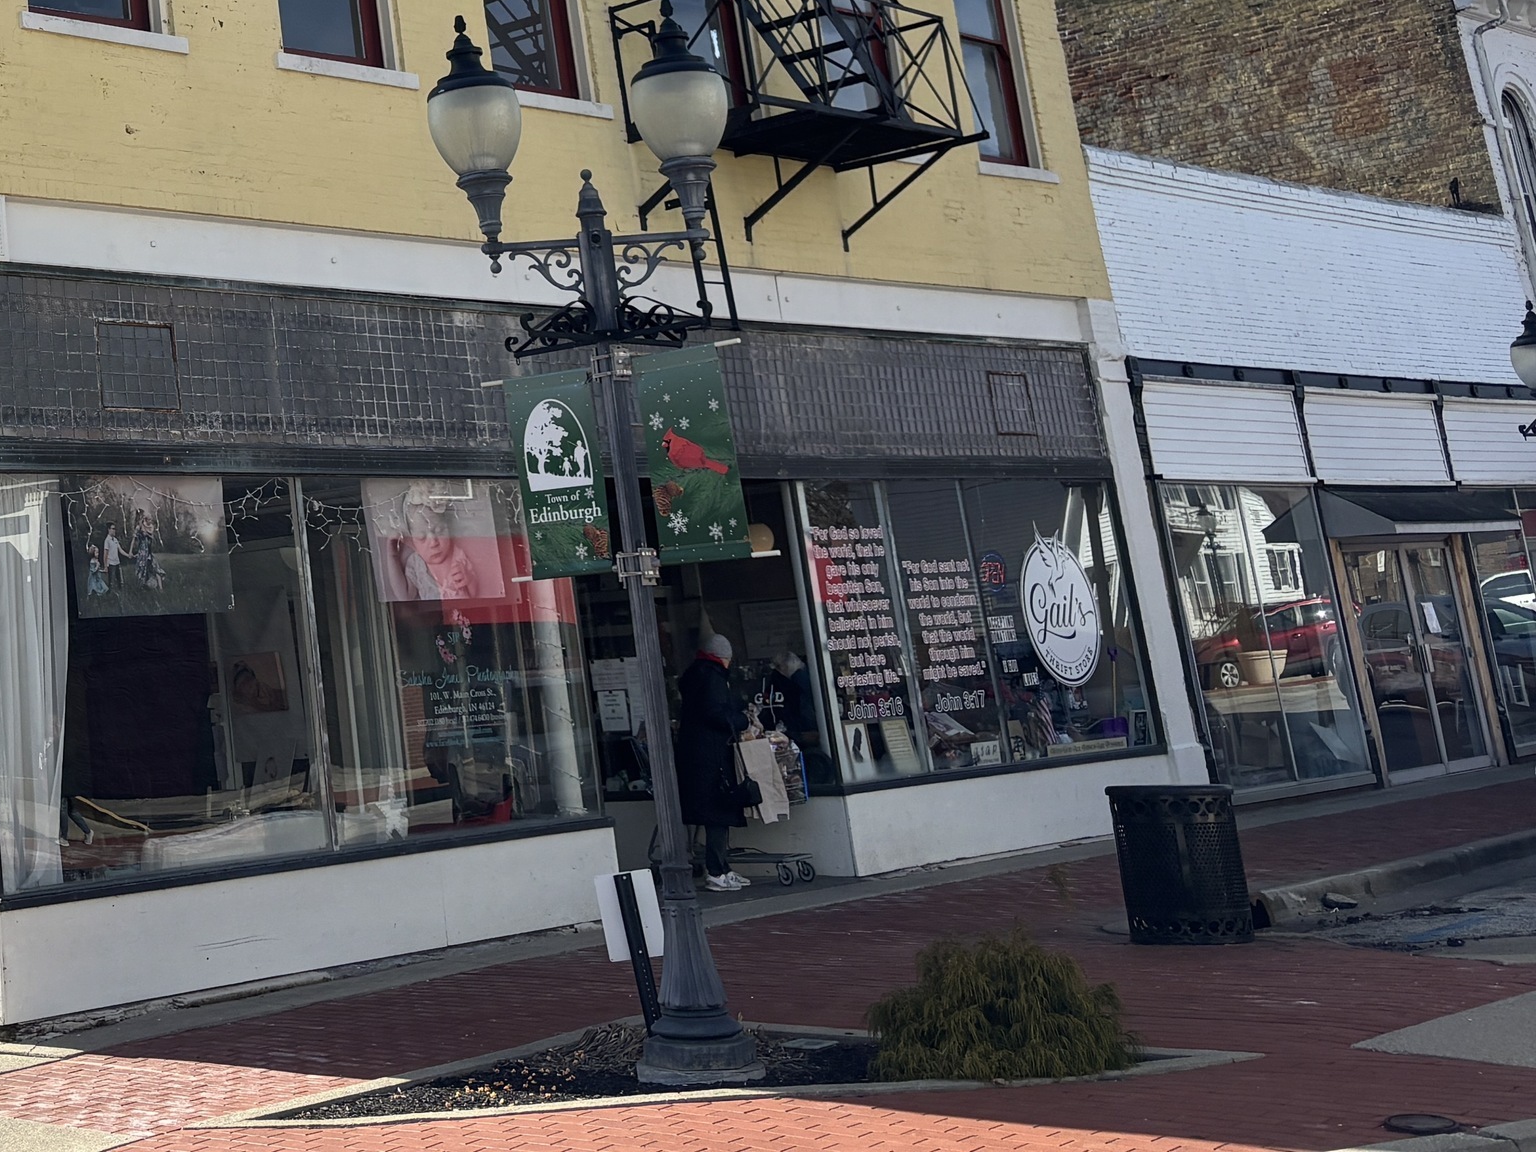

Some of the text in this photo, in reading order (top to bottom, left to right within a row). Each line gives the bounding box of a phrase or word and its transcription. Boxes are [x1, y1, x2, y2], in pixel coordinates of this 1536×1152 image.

[545, 490, 580, 504] Town of
[529, 502, 602, 524] Edinburgh
[829, 526, 848, 540] God
[848, 528, 860, 540] so
[860, 525, 883, 540] loved
[813, 542, 885, 560] the world, that he
[826, 560, 879, 580] gave his only
[920, 560, 938, 574] God
[938, 559, 956, 573] sent
[956, 558, 970, 572] not
[826, 578, 884, 597] begotten Son,
[908, 576, 968, 592] his Son into the
[826, 598, 890, 614] that whosoever
[907, 592, 977, 609] world to condemn
[918, 610, 972, 626] the world, but
[1030, 582, 1094, 644] Gail's
[828, 614, 894, 632] believeth in him
[828, 632, 902, 651] should not perish,
[922, 626, 976, 644] that the world
[848, 652, 886, 668] but have
[928, 644, 976, 662] through him
[1045, 646, 1094, 676] THRIFT STORE
[837, 668, 903, 688] everlasting life."
[922, 665, 946, 682] might
[946, 664, 958, 678] be
[958, 660, 986, 677] saved."
[470, 688, 486, 698] Cross
[935, 690, 985, 712] John 3:17
[468, 702, 478, 712] IN
[848, 696, 904, 720] John 3:16
